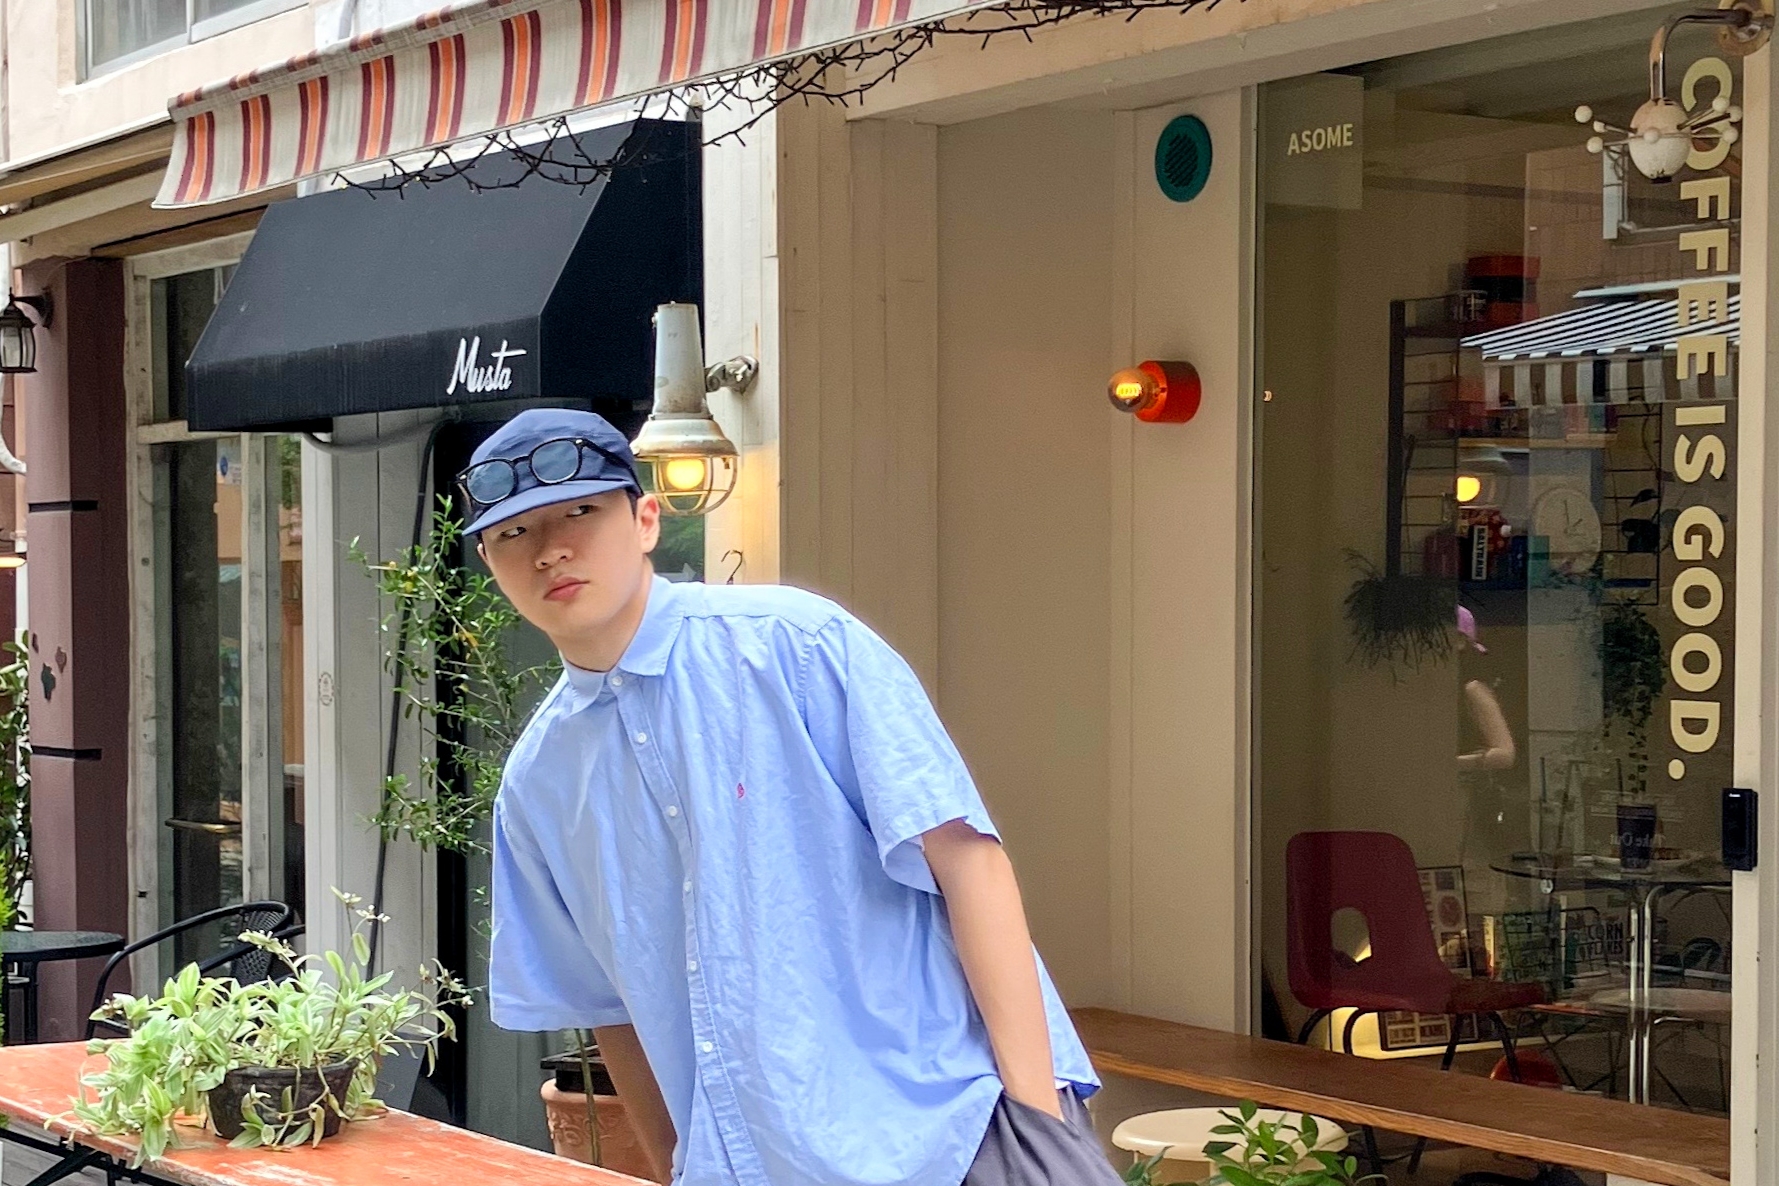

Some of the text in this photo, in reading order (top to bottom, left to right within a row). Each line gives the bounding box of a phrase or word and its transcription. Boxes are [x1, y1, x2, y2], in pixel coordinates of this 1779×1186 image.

[1286, 123, 1354, 156] ASOME
[446, 335, 528, 396] Musta
[1668, 56, 1734, 781] COFFEE IS GOOD.
[1588, 923, 1624, 940] CORN
